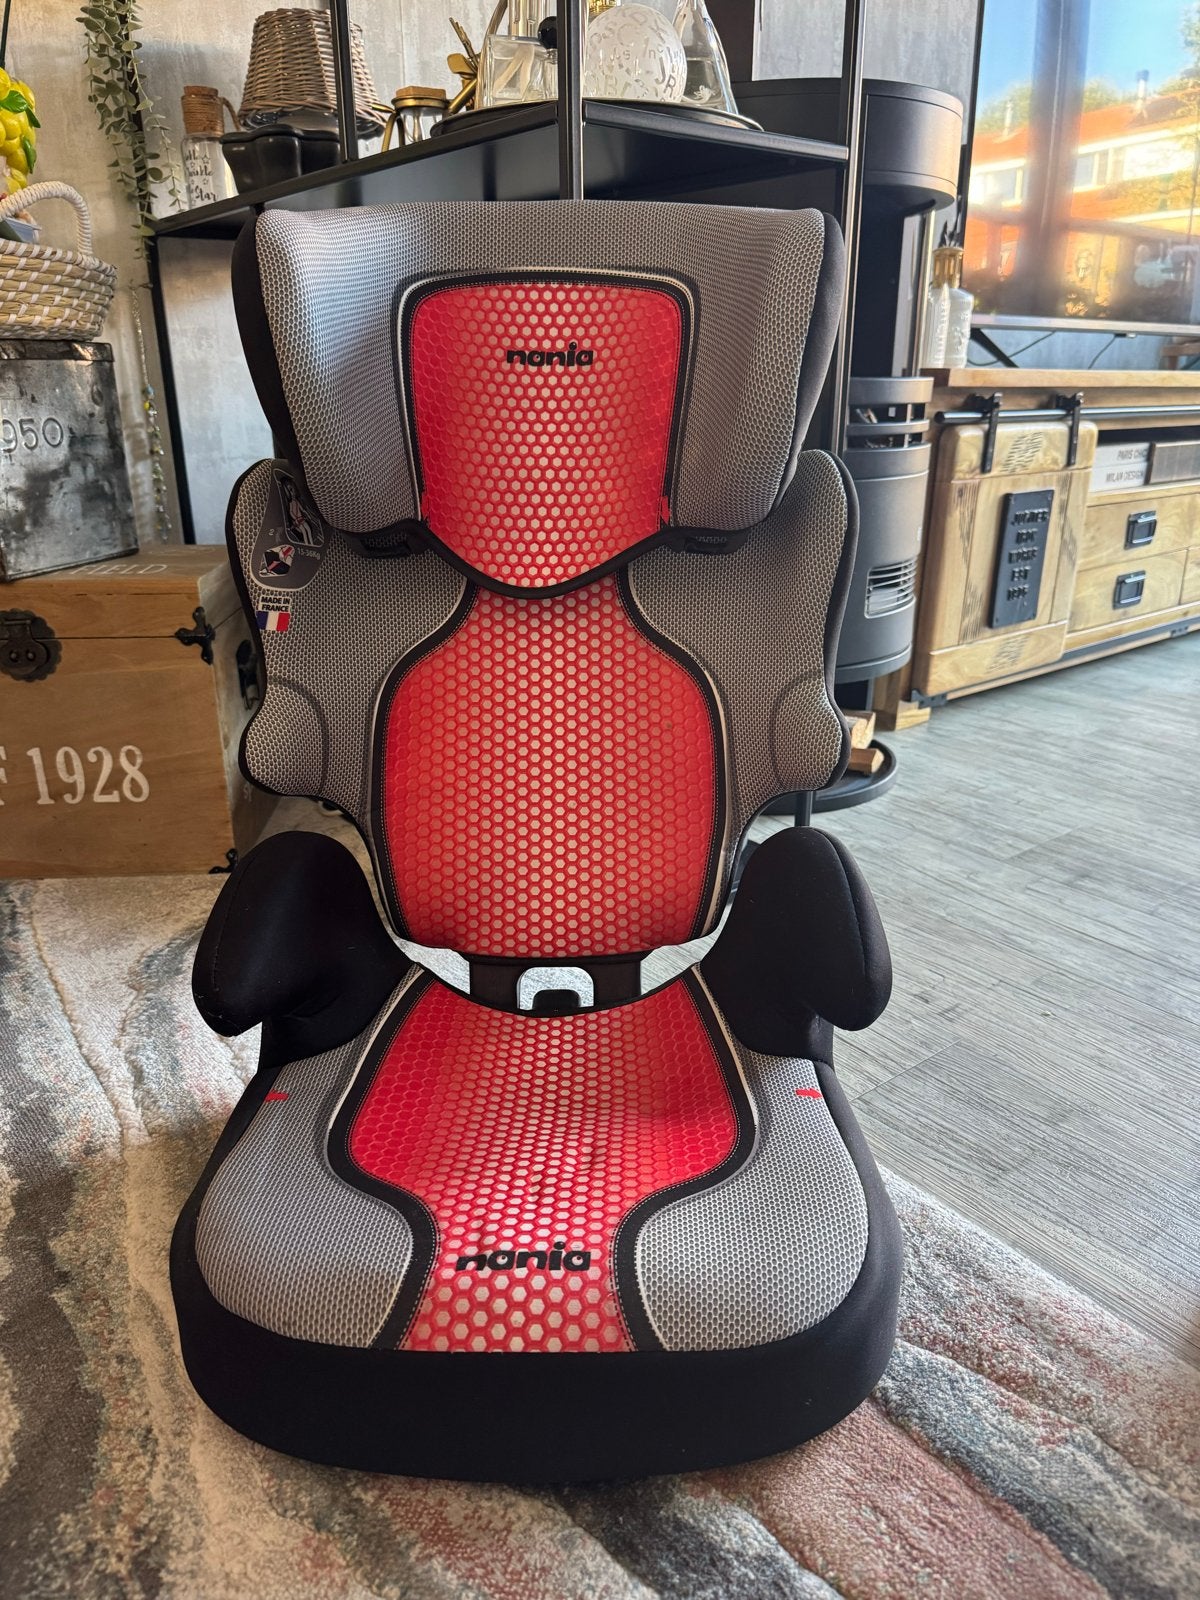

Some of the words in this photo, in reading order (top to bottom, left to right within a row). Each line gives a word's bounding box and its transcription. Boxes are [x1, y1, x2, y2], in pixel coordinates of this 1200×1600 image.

[507, 342, 594, 366] nania
[54, 564, 168, 575] FIELD
[261, 596, 282, 604] MADE
[283, 597, 290, 605] IN
[262, 604, 289, 612] FRANCE
[26, 745, 150, 805] 1928
[456, 1241, 591, 1272] nania
